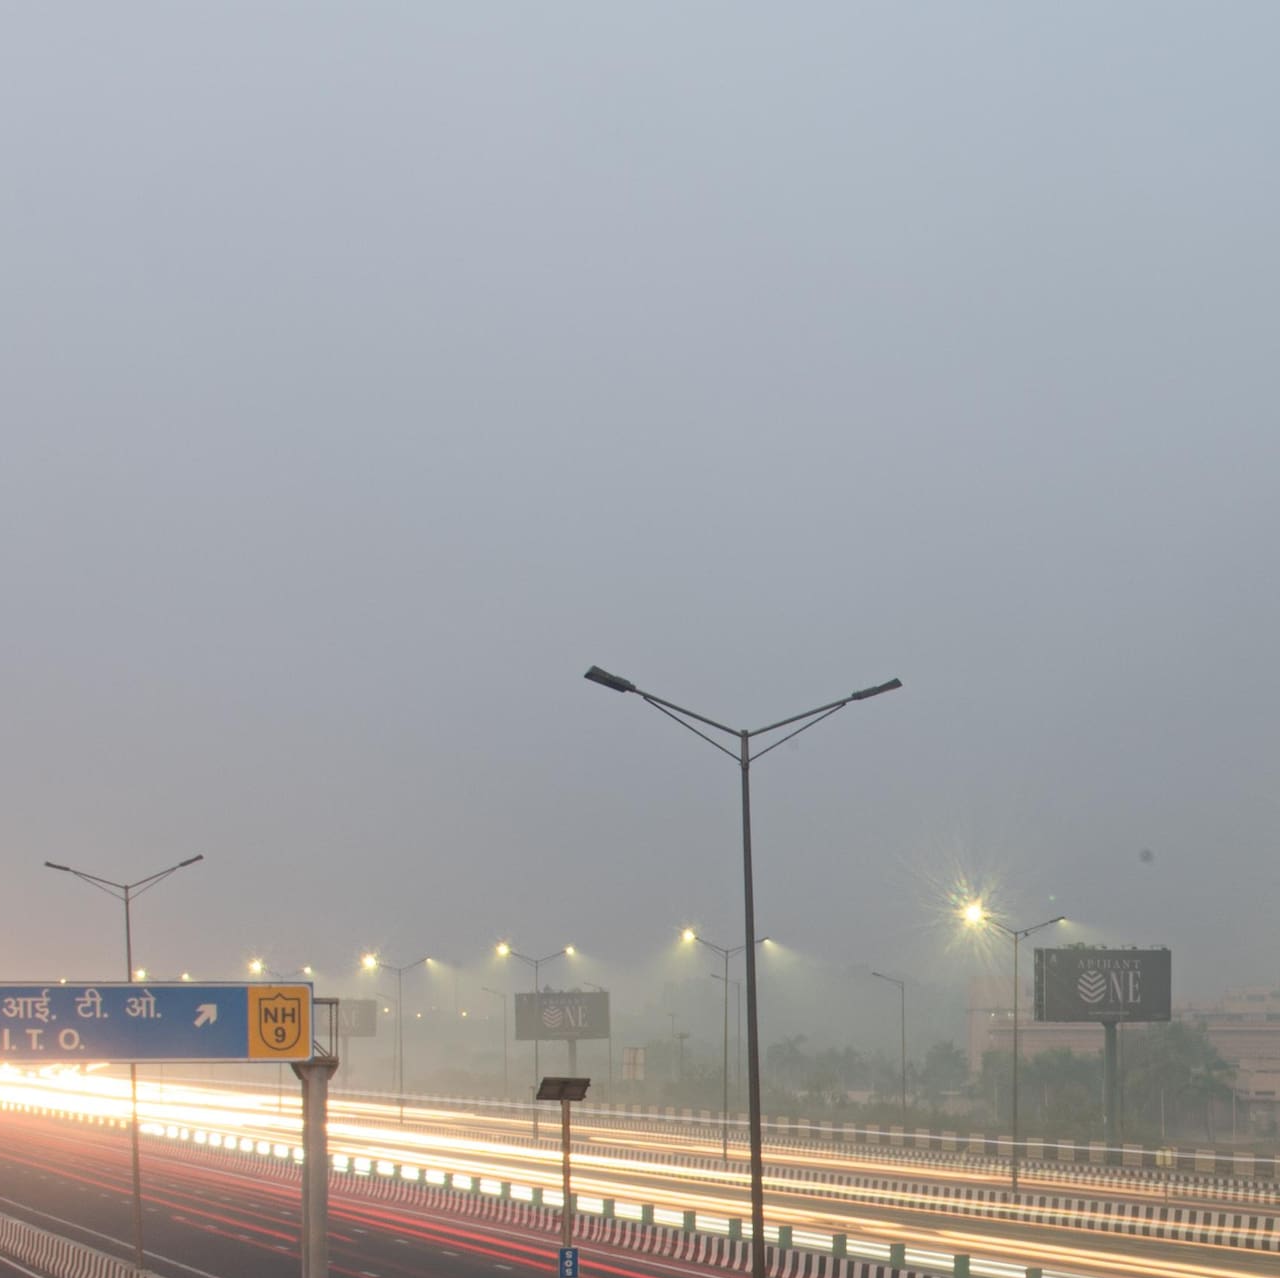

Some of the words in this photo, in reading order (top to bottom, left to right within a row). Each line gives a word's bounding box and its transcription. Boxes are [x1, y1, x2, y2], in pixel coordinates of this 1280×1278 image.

[1, 989, 57, 1022] आई.
[75, 989, 109, 1019] टी.
[125, 989, 162, 1019] ओ.
[263, 1007, 296, 1023] NH
[3, 1029, 17, 1050] I.
[25, 1029, 44, 1050] T.
[59, 1028, 85, 1050] O.
[273, 1027, 286, 1043] 9
